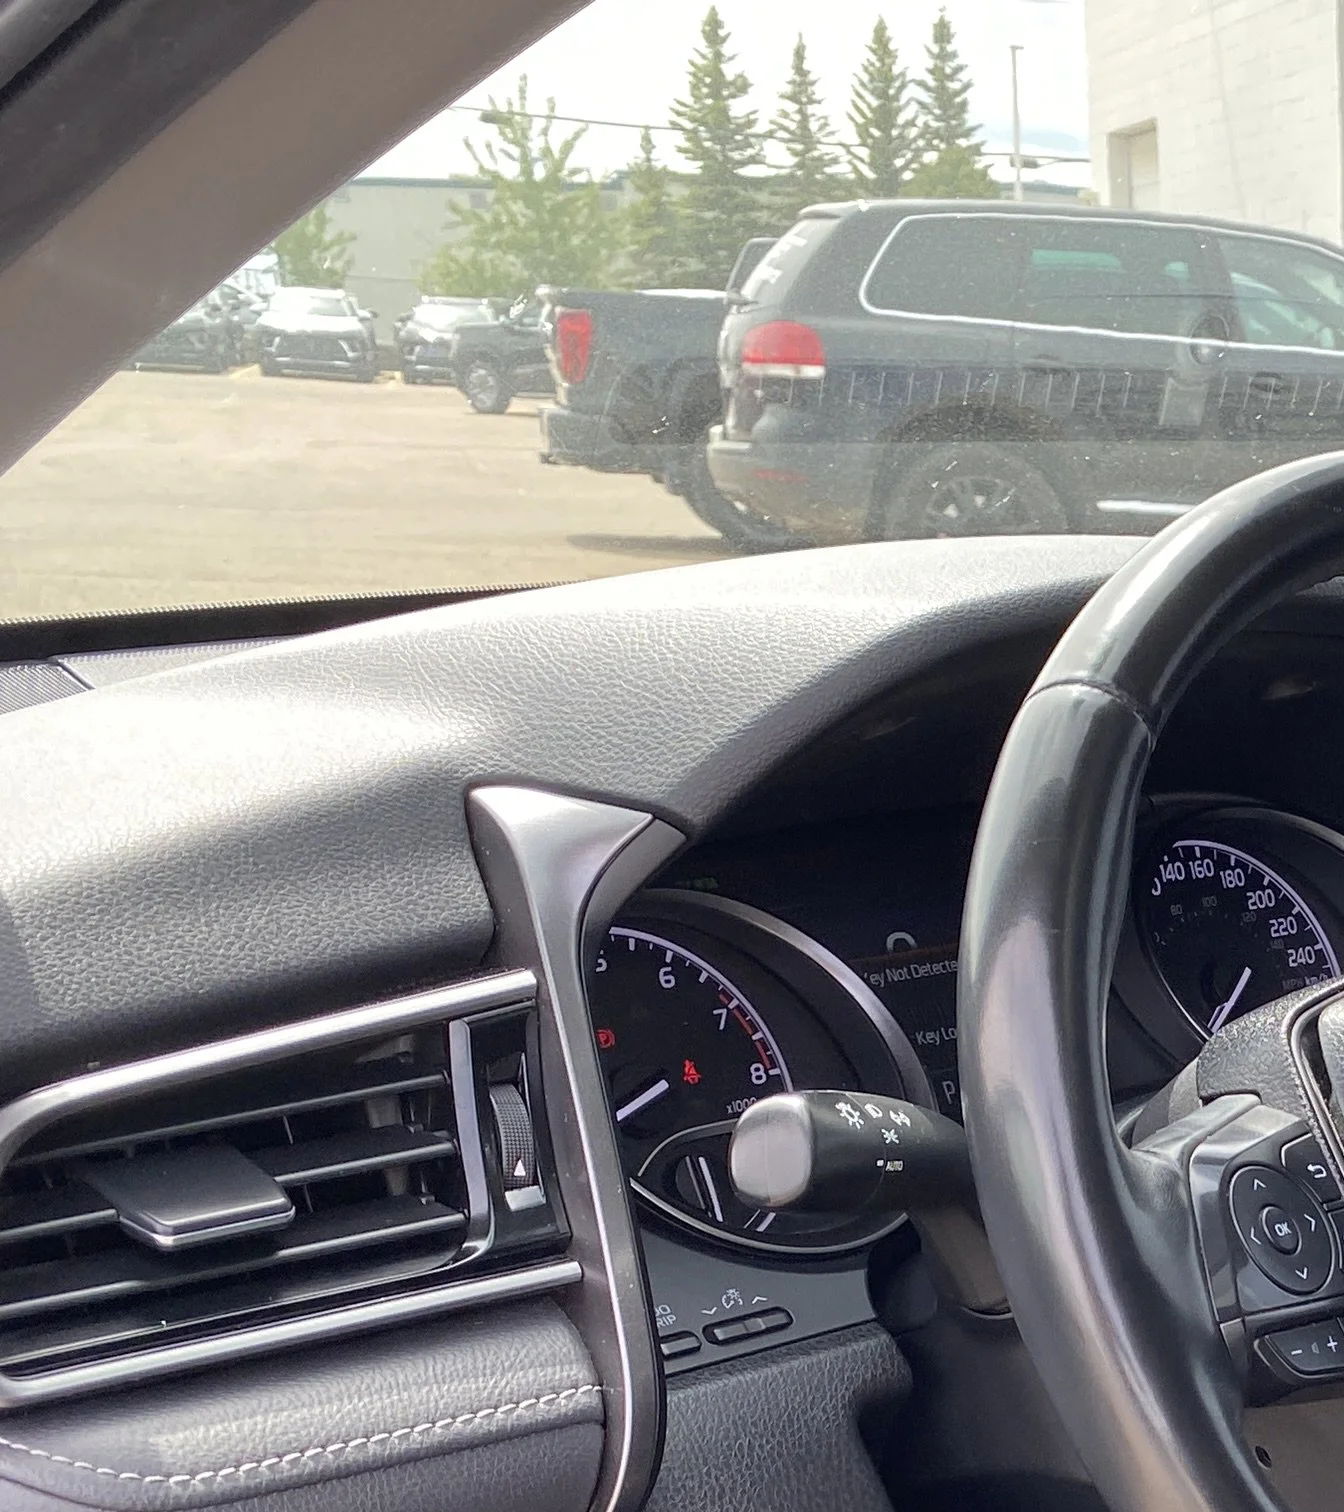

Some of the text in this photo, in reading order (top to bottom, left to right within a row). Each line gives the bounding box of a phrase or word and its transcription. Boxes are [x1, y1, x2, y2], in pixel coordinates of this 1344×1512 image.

[1159, 861, 1185, 883] 140
[1189, 858, 1214, 879] 160
[1219, 868, 1245, 889] 180
[1246, 889, 1275, 910] 200
[1269, 916, 1298, 938] 220
[1287, 945, 1316, 967] 240
[658, 966, 676, 989] 6
[864, 960, 959, 987] ey Not Detecte
[712, 1008, 728, 1030] 7
[915, 1030, 941, 1046] Key
[749, 1062, 767, 1085] 8
[942, 1080, 956, 1105] P
[885, 1160, 904, 1172] AUTO
[1274, 1223, 1292, 1237] OK
[656, 1314, 677, 1328] RIP
